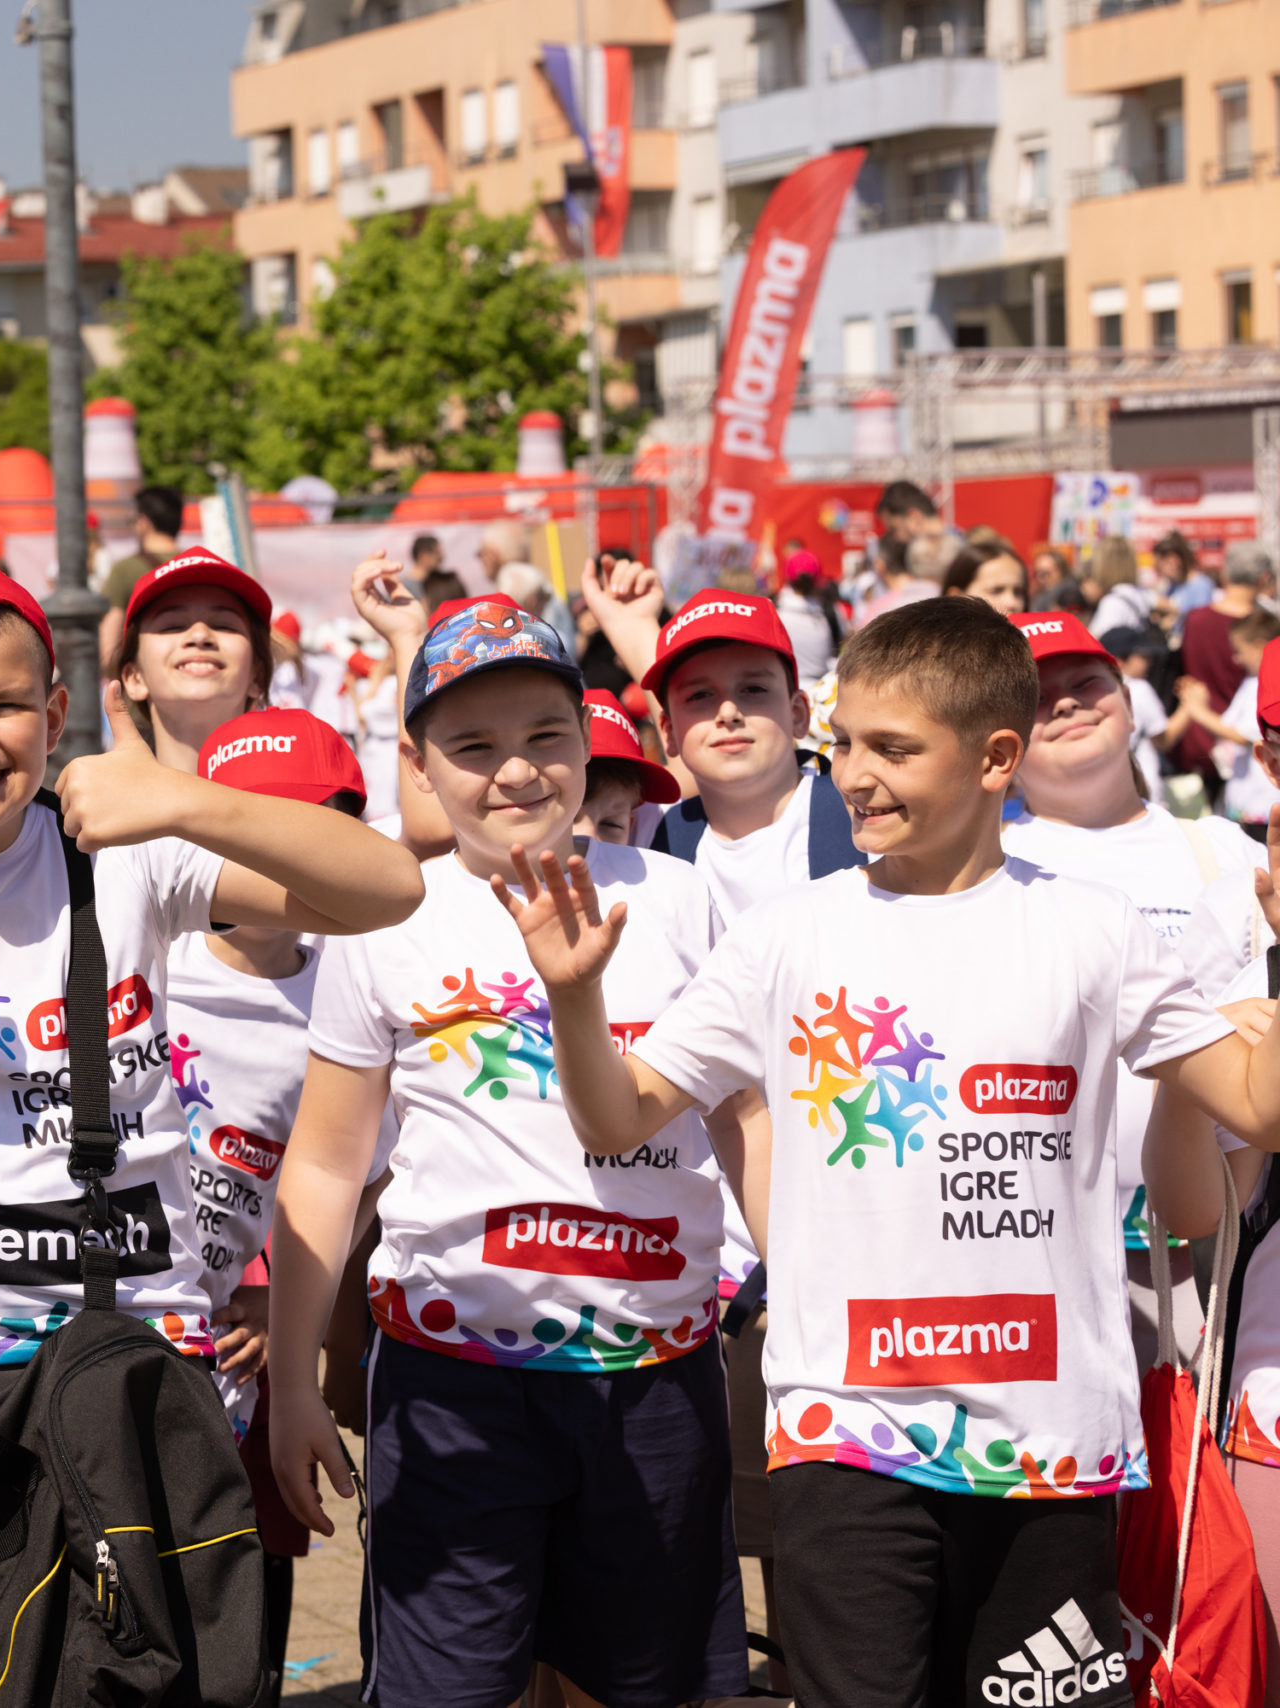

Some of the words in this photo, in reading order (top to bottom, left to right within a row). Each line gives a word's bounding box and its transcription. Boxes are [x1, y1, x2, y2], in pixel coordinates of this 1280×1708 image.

[716, 237, 811, 462] plazma
[665, 602, 757, 646] plazma
[207, 735, 297, 780] plazma
[974, 1072, 1068, 1108] plazma
[937, 1131, 1072, 1163] SPORTSKE
[940, 1170, 1019, 1202] IGRE
[506, 1206, 670, 1256] plazma
[981, 1651, 1128, 1708] adidas
